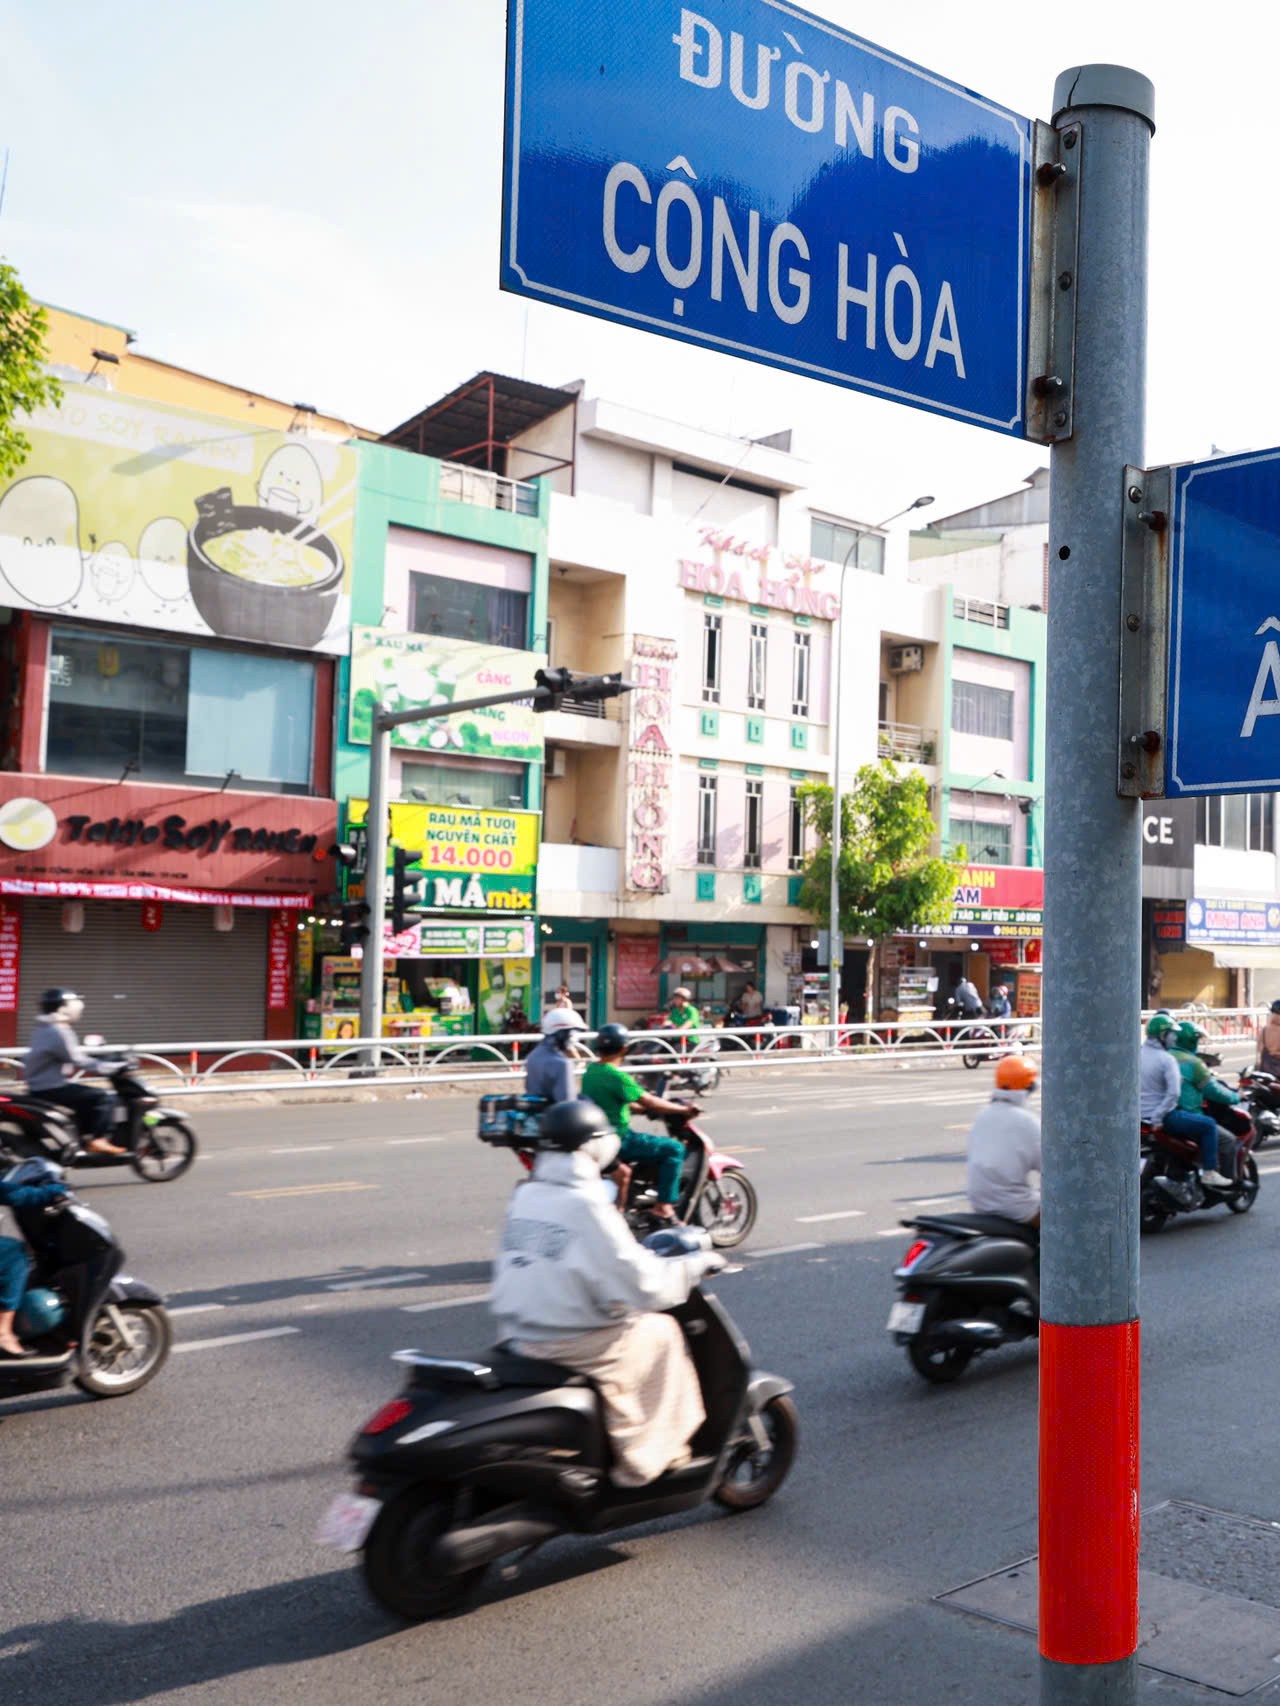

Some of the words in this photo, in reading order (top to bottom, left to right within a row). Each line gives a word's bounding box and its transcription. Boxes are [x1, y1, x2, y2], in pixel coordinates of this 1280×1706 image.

[672, 7, 920, 174] ĐƯỜNG
[603, 155, 811, 325] CỘNG
[837, 232, 967, 379] HÒA
[678, 559, 750, 603] HOA
[426, 829, 480, 844] NGUYÊN
[430, 845, 513, 868] 14.000
[432, 872, 488, 908] MÁ
[486, 887, 534, 909] mix
